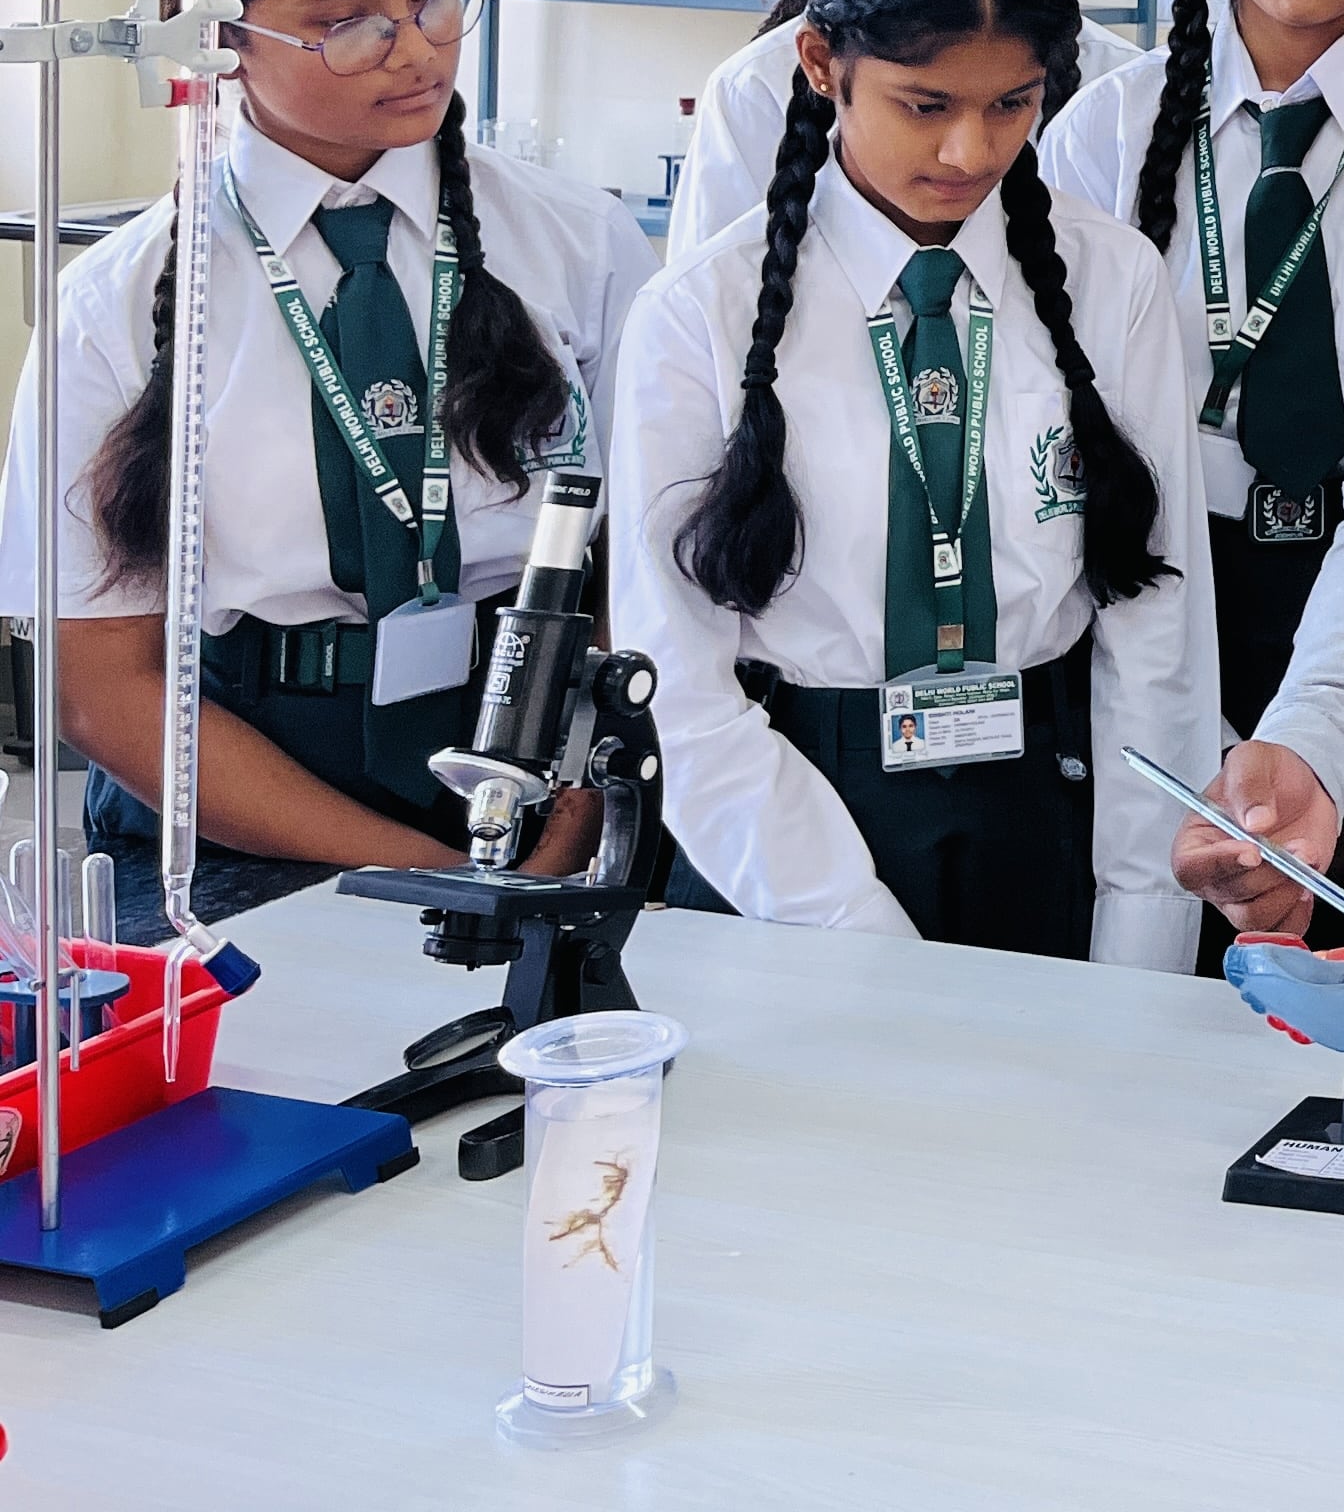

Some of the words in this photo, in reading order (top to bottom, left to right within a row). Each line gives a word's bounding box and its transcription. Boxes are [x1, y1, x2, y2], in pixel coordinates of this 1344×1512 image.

[1199, 123, 1210, 170] SCHOOL
[1200, 171, 1214, 215] PUBLIC
[1204, 215, 1219, 258] WORLD
[1270, 260, 1293, 297] DELHI
[1290, 222, 1317, 261] WORLD
[438, 270, 454, 321] SCHOOL
[1211, 258, 1223, 295] DELHI
[286, 297, 319, 347] SCHOOL
[310, 347, 342, 394] PUBLIC
[878, 331, 901, 387] SCHOOL
[972, 325, 988, 378] SCHOOL
[332, 394, 365, 440] WORLD
[891, 387, 913, 435] PUBLIC
[971, 379, 985, 428] PUBLIC
[355, 437, 387, 477] DELHI
[903, 434, 927, 483] WORLD
[968, 430, 981, 478] WORLD
[568, 486, 591, 497] FIELD
[961, 479, 976, 520] DELHI
[962, 683, 987, 693] PUBLIC
[988, 680, 1016, 690] SCHOOL
[1282, 1140, 1343, 1154] HUMAN
